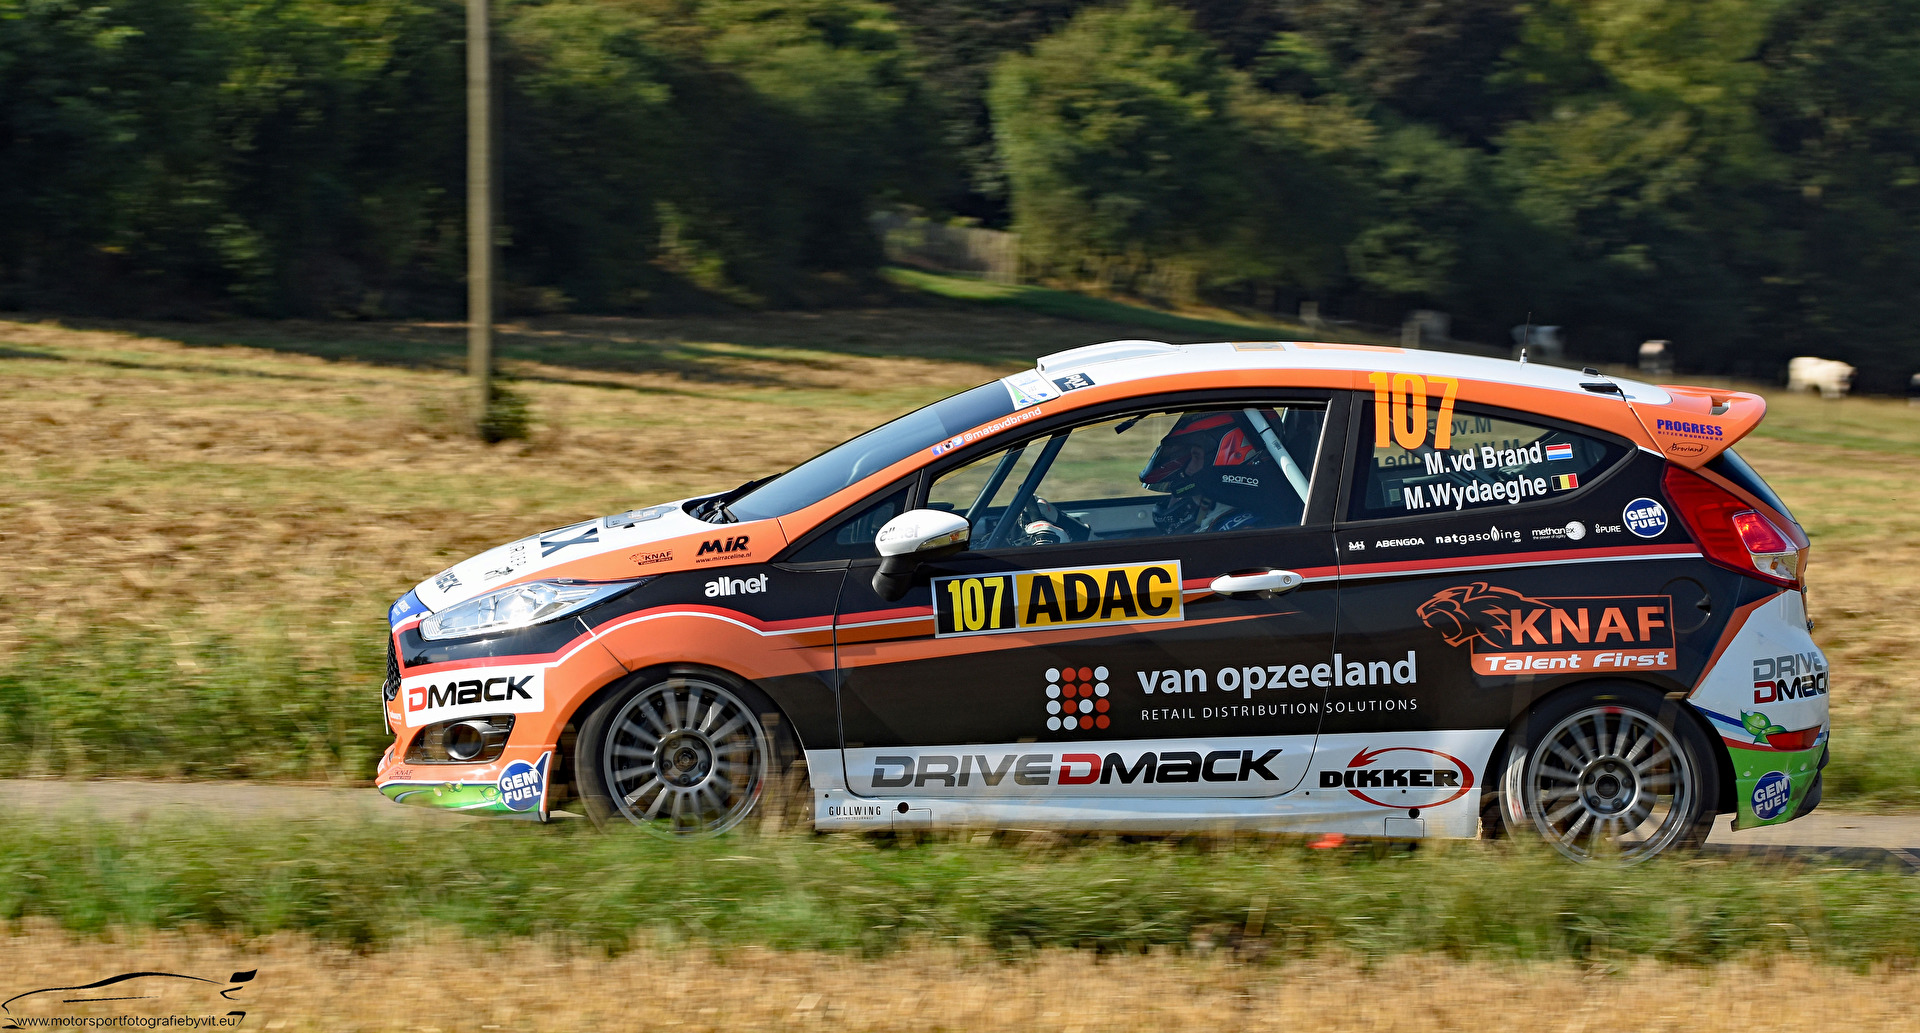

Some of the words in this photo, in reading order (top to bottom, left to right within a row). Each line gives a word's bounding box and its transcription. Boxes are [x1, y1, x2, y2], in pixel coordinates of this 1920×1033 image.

[1368, 371, 1459, 450] 107
[963, 406, 1042, 441] @matsvdbrand
[1657, 419, 1723, 436] PROGRESS
[1424, 446, 1476, 475] M.vd
[1481, 441, 1543, 469] Brand
[1403, 474, 1548, 511] M.Wydaeghe
[1627, 505, 1662, 521] GEM
[1630, 515, 1665, 530] FUEL
[1532, 527, 1575, 536] methanex
[1375, 537, 1425, 548] ABENGOA
[644, 550, 672, 561] KNAF
[704, 573, 769, 598] allnet
[947, 576, 1004, 632] 107
[1025, 567, 1172, 624] ADAC
[1510, 606, 1665, 646] KNAF
[1484, 654, 1581, 671] Talent
[1593, 651, 1669, 668] First
[1753, 651, 1823, 681] DRIVE
[1136, 669, 1207, 694] van
[1216, 650, 1417, 698] opzeeland
[1141, 706, 1196, 720] RETAIL
[1203, 703, 1319, 719] DISTRIBUTION
[1325, 699, 1418, 713] SOLUTIONS
[501, 770, 539, 791] GEM
[1319, 769, 1460, 788] DIKKER
[504, 784, 541, 804] FUEL
[1753, 776, 1789, 803] GEM
[828, 806, 881, 816] GULLWING
[1755, 792, 1789, 815] FUEL
